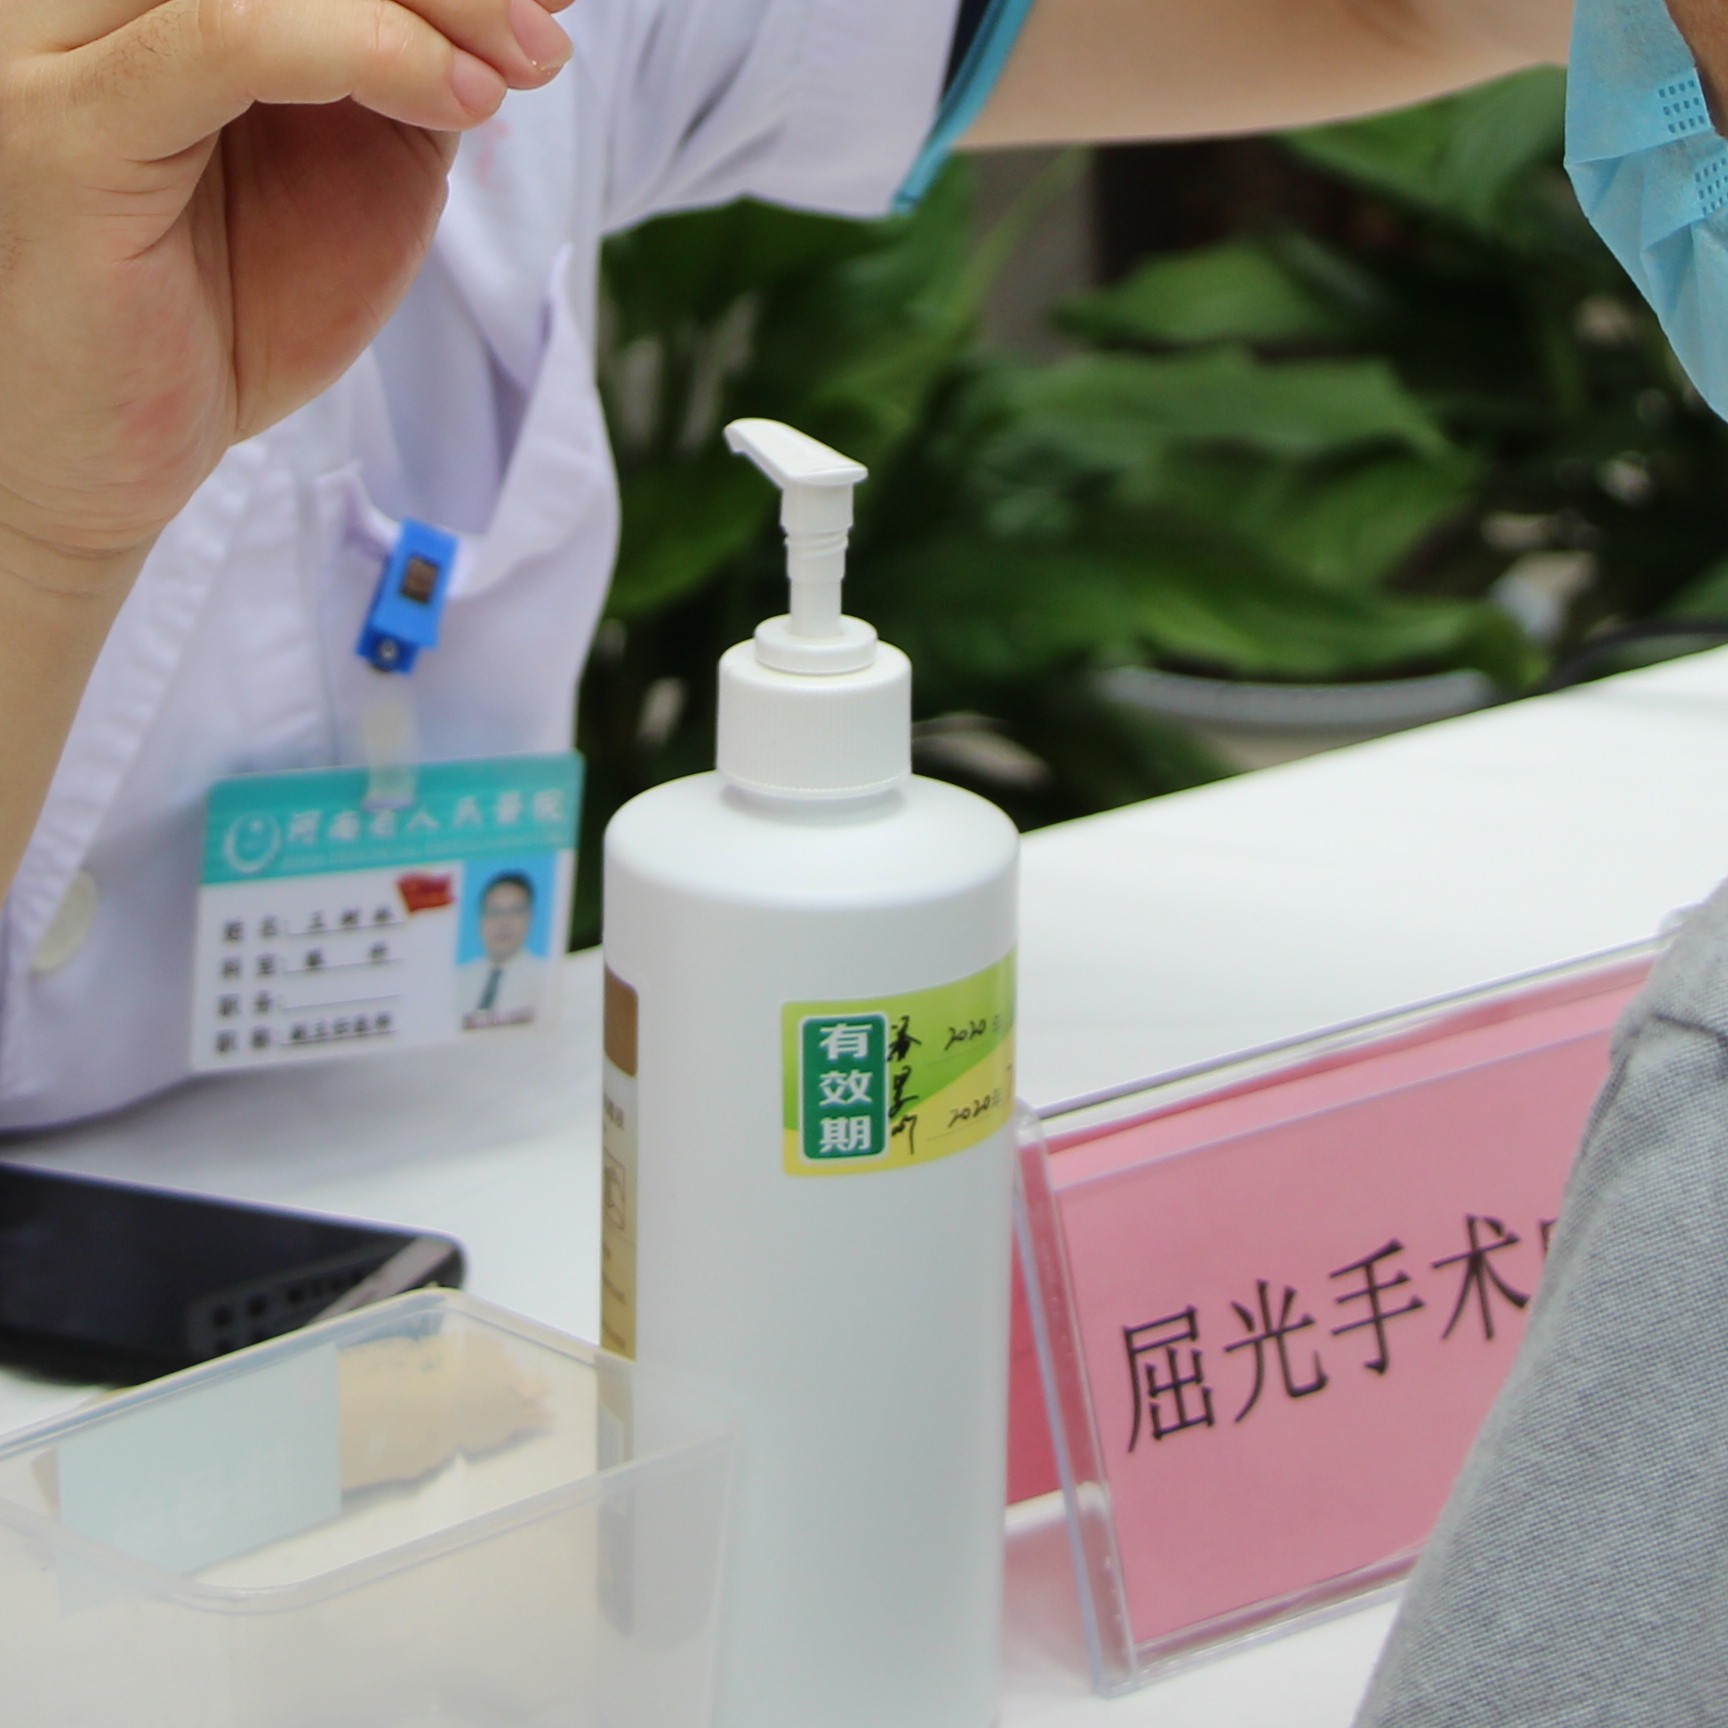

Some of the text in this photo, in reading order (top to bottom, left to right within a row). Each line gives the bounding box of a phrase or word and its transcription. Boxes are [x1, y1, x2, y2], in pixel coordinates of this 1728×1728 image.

[820, 1022, 873, 1153] 有效期
[1122, 1214, 1557, 1453] 屈光手术
